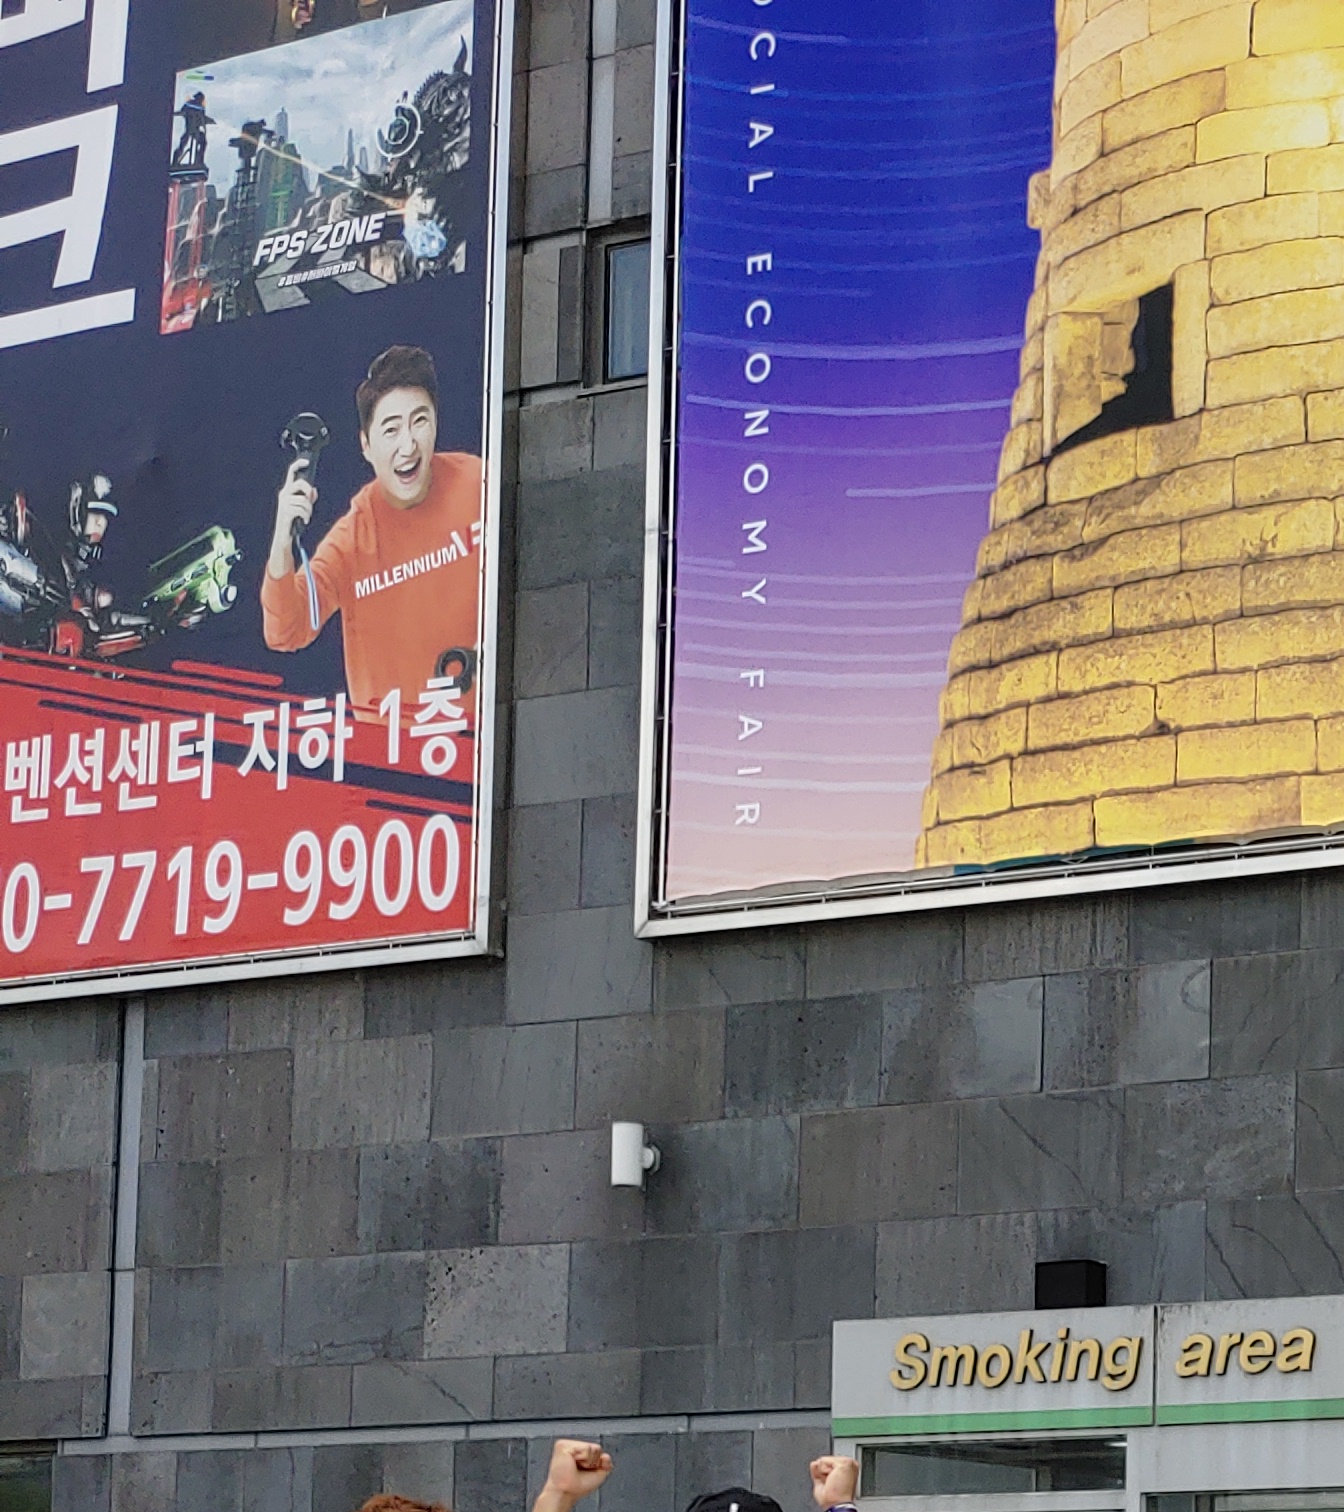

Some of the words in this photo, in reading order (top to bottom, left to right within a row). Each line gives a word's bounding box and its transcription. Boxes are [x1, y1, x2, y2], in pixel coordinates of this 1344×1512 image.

[748, 0, 776, 193] CIAL
[253, 229, 309, 267] FPS
[310, 211, 387, 255] ZONE
[741, 252, 773, 605] ECONOMY
[5, 712, 215, 824] 벤션센터
[237, 692, 354, 792] 지하
[378, 675, 469, 777] 1층
[734, 667, 766, 826] FAIR
[2, 813, 461, 955] 0-7719-9900
[890, 1328, 1142, 1390] Smoking
[1175, 1327, 1317, 1378] area
